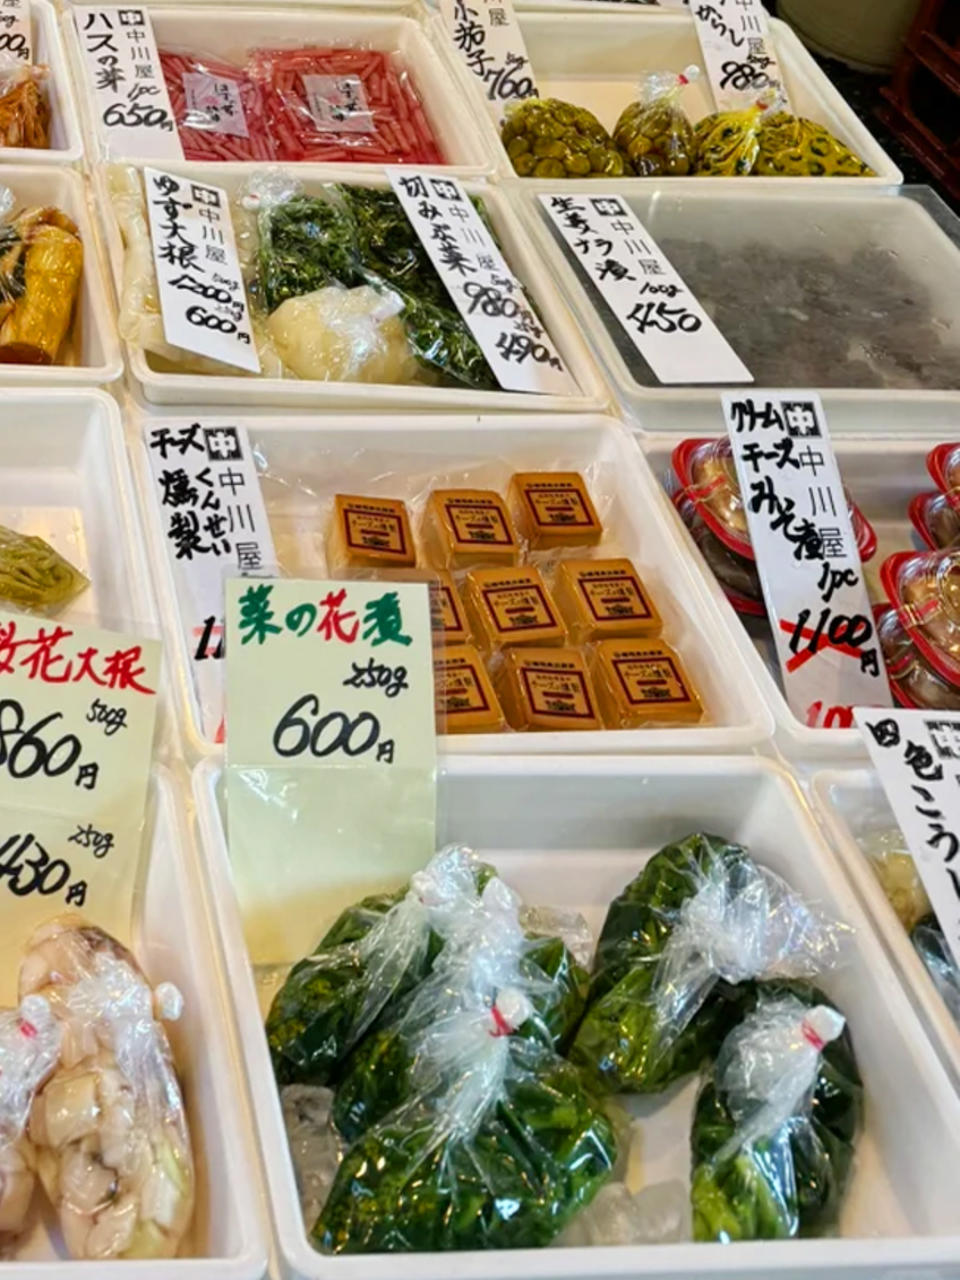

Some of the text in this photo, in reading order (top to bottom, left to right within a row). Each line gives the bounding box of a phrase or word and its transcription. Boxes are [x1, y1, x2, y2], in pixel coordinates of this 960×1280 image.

[695, 3, 745, 48] からし
[83, 11, 129, 93] ハスの芽
[101, 101, 174, 133] 650円
[151, 174, 206, 273] ゆず大根
[398, 174, 476, 279] 切みぶ菜
[167, 272, 246, 313] 1200円
[463, 280, 537, 327] 980円
[184, 304, 252, 345] 600円
[625, 301, 703, 334] 450
[494, 330, 565, 373] 490円
[730, 400, 786, 434] クリーム
[149, 423, 206, 460] チーズ
[741, 436, 801, 474] チーズ
[195, 467, 232, 556] くんせい
[218, 466, 264, 570] 中川屋
[749, 479, 827, 562] みそ漬
[798, 444, 850, 559] 中川屋
[816, 562, 860, 603] 1pc
[238, 582, 413, 648] 菜の花漬
[788, 606, 881, 678] 1100円
[342, 656, 410, 699] 250g
[85, 697, 129, 736] 500g
[272, 693, 395, 764] 600円
[67, 823, 116, 860] 250g
